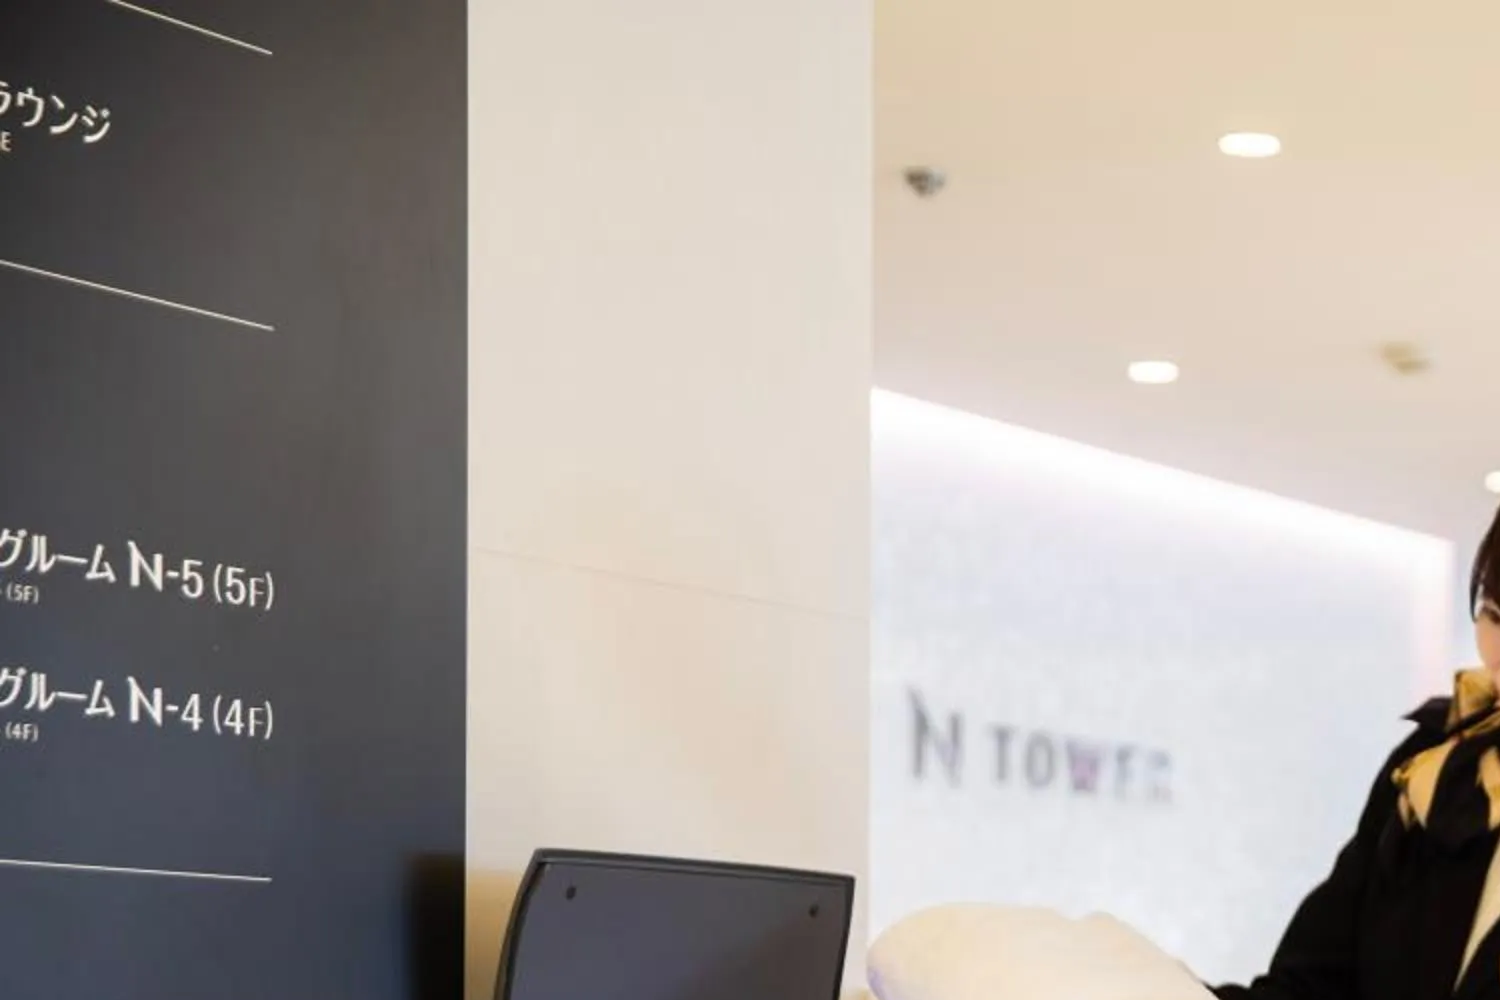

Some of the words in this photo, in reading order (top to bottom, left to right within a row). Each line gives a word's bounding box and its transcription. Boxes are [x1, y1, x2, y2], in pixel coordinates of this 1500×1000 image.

[0, 528, 117, 583] グルーム
[127, 540, 204, 598] N-5
[213, 563, 274, 610] (5F)
[0, 667, 116, 718] グルーム
[127, 676, 204, 732] N-4
[212, 695, 273, 740] (4F)
[905, 682, 964, 788] N
